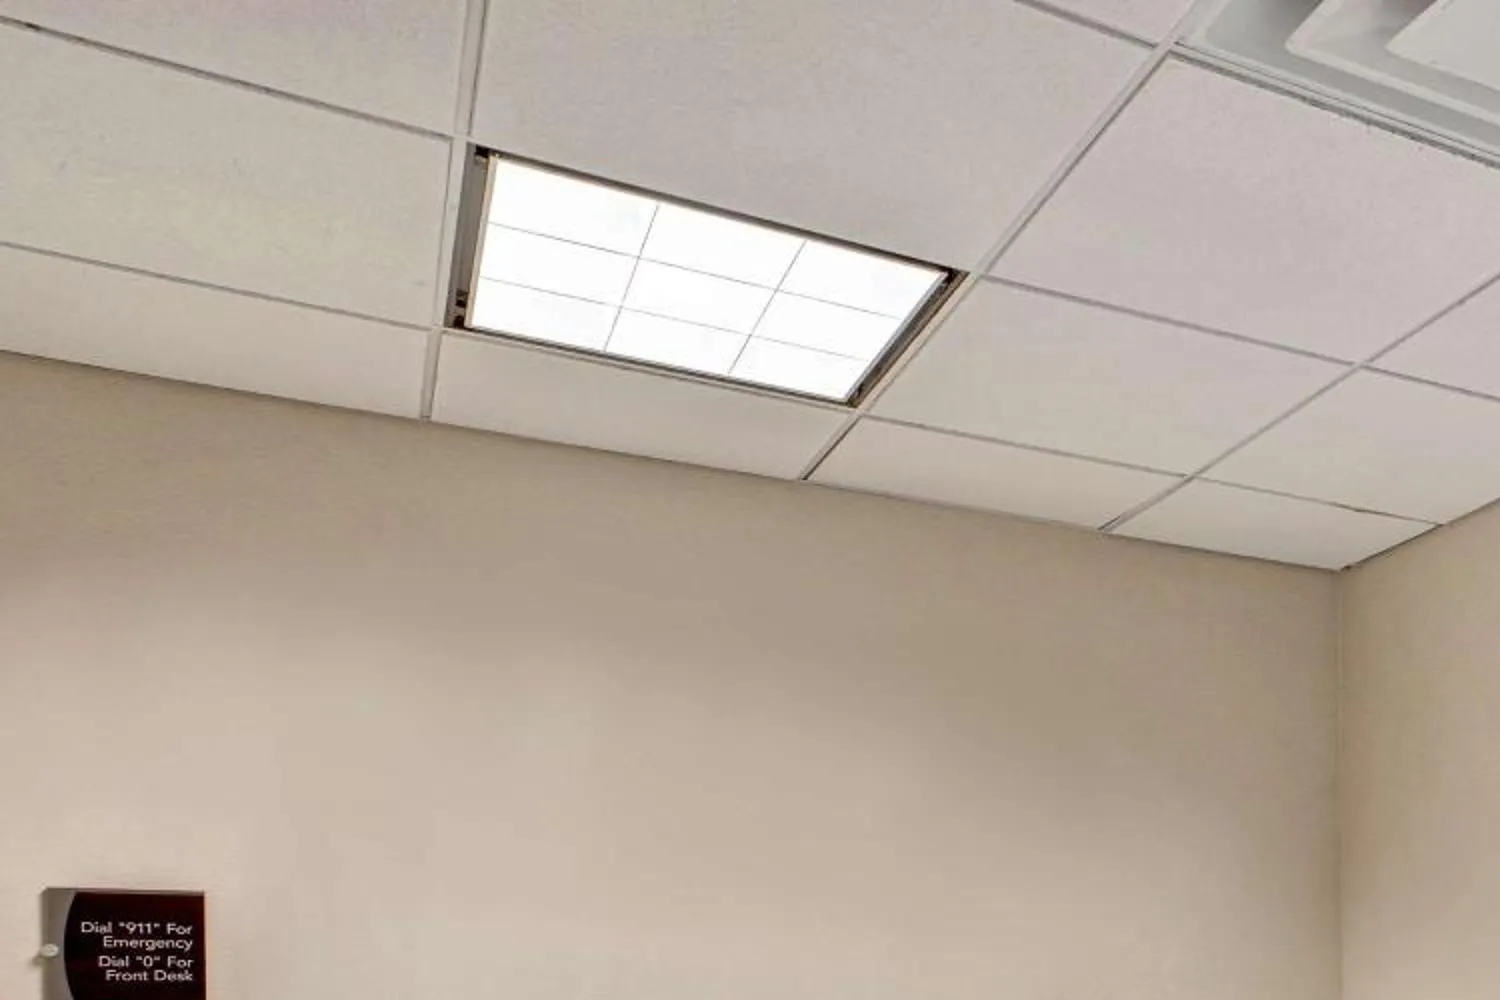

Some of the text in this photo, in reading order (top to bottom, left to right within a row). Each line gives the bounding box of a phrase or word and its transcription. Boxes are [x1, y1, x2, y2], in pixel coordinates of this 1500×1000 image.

[81, 921, 193, 935] Dial "911" For
[103, 936, 193, 950] Emergency
[99, 955, 129, 967] Dial
[168, 957, 194, 968] For
[106, 970, 193, 981] Front Desk
